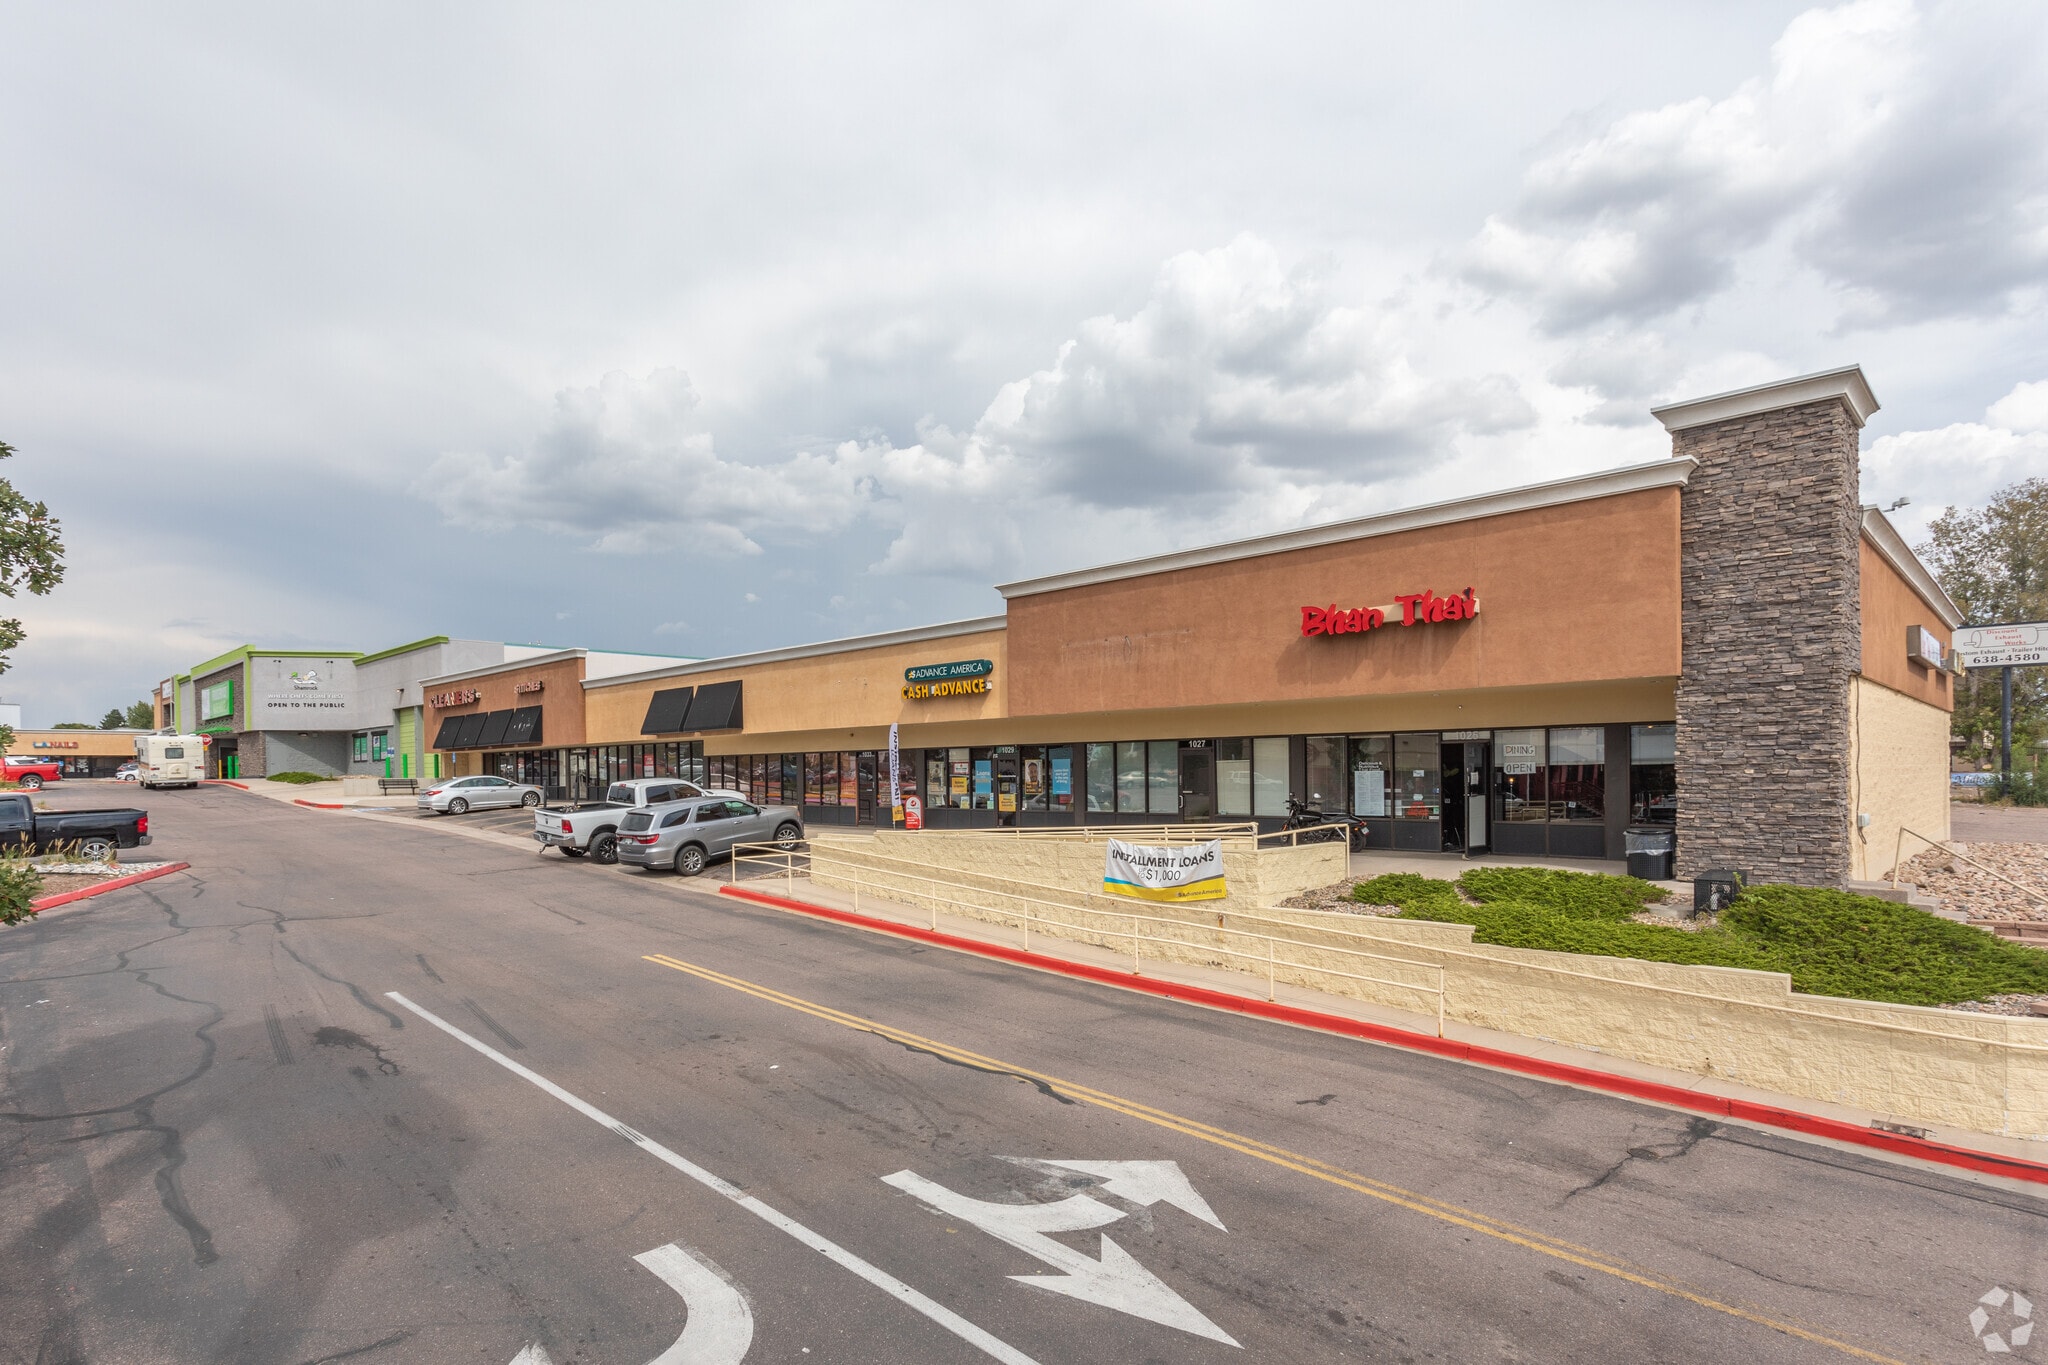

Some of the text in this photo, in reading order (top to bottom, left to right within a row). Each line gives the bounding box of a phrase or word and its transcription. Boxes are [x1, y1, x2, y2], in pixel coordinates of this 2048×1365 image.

[1300, 586, 1475, 637] Bhan Thai
[1986, 628, 2018, 636] Discount
[1973, 653, 2040, 665] 638-4580
[915, 663, 984, 679] ADVANCE AMERICA
[901, 678, 985, 700] CASH ADVANCE
[1189, 740, 1206, 748] 1027
[1505, 745, 1534, 754] DINING
[1506, 763, 1533, 773] OPEN
[1111, 849, 1215, 869] INSTALLMENT LOANS
[1145, 868, 1181, 882] $1,000
